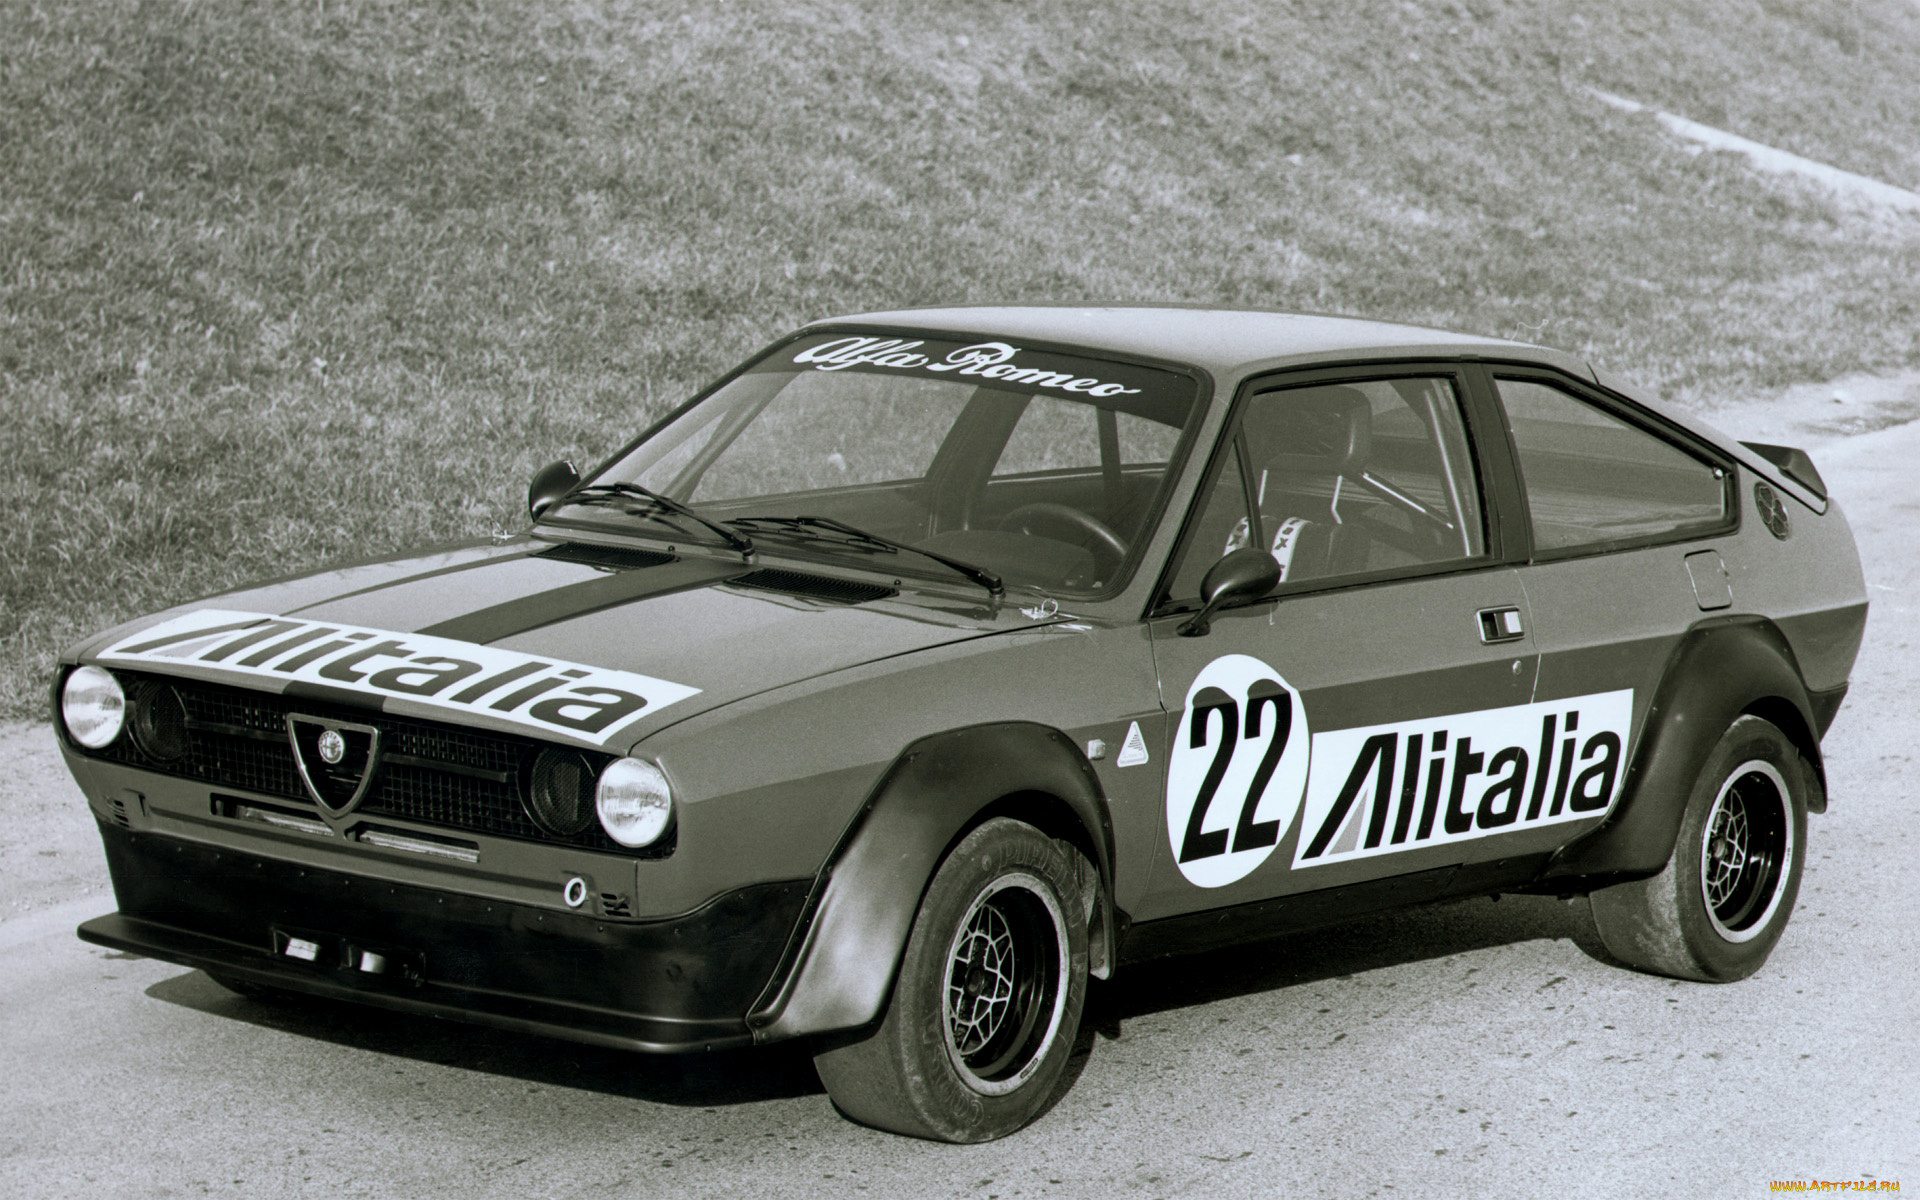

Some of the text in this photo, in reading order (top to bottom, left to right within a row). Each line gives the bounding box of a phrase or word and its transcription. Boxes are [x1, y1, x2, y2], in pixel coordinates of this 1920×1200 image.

[793, 337, 1142, 397] Alfa Romeo
[114, 618, 649, 734] Alitalia
[1178, 678, 1292, 865] 22
[1300, 710, 1621, 861] Alitalia
[997, 838, 1085, 928] PIRELLI
